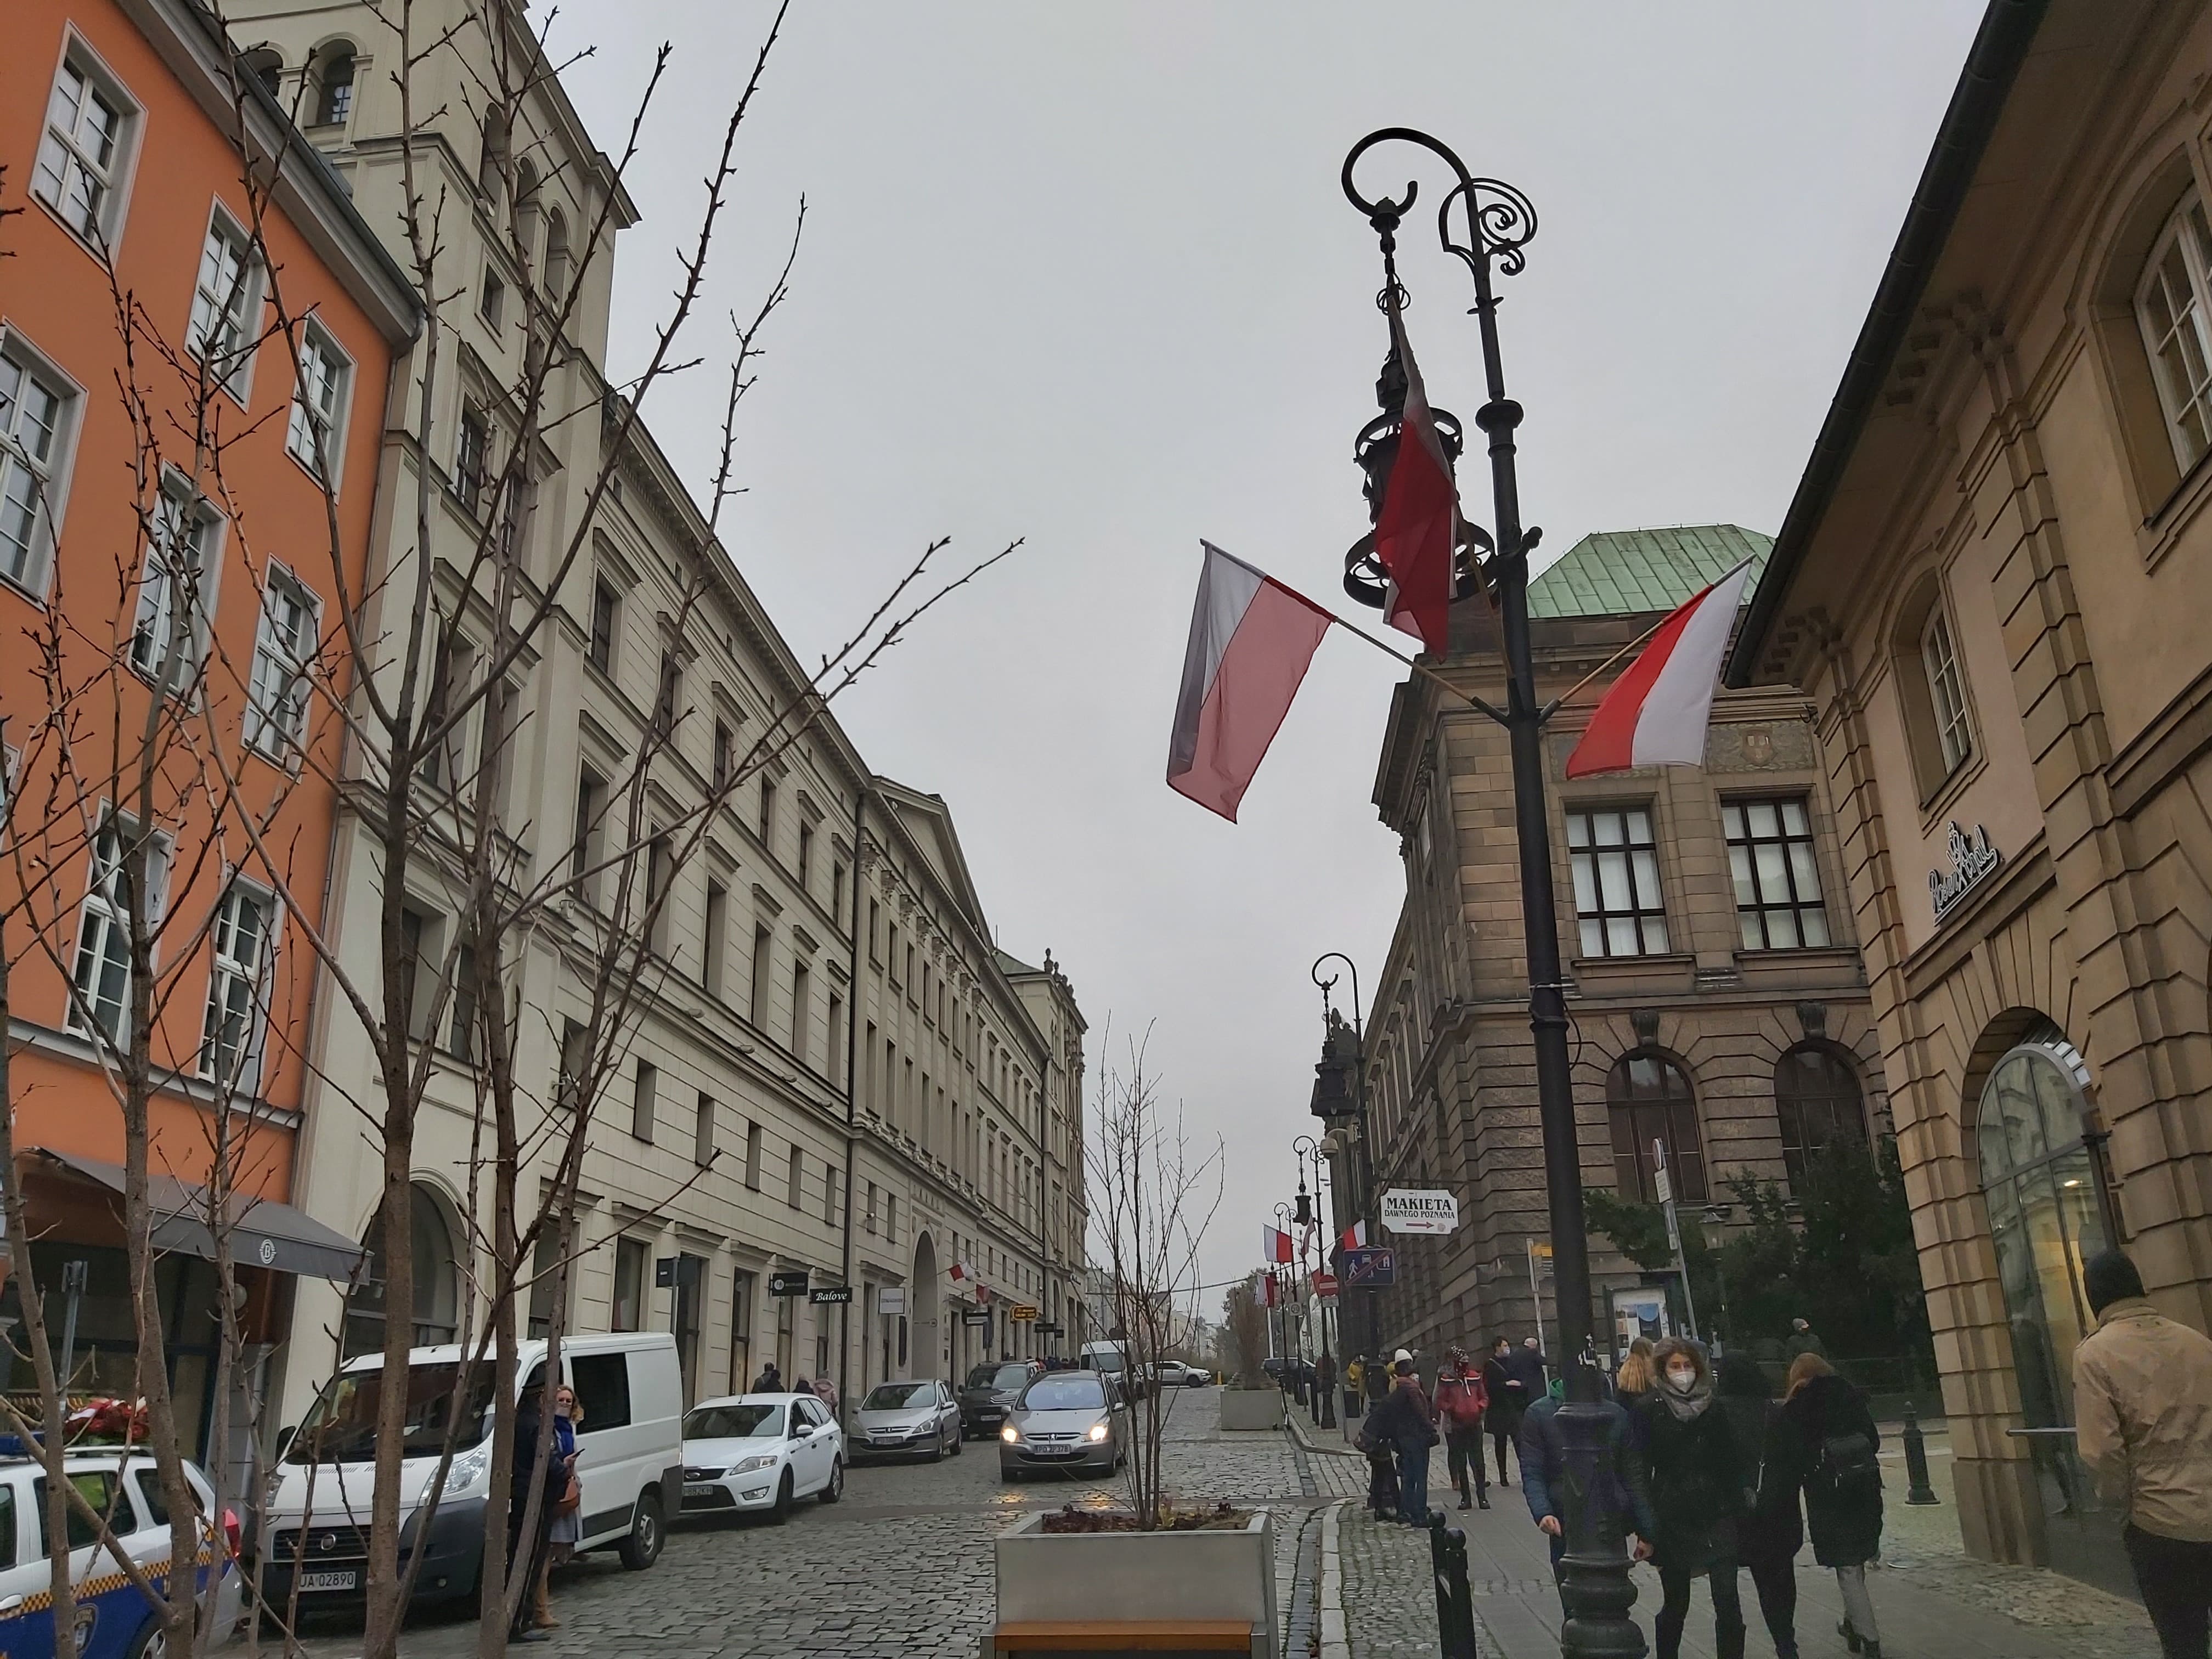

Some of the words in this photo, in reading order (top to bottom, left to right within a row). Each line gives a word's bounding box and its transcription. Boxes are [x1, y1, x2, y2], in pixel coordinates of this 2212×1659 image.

[1387, 1198, 1452, 1210] MAKIETA
[265, 1245, 270, 1257] B
[816, 1291, 847, 1301] Balove
[319, 1573, 354, 1587] 02890
